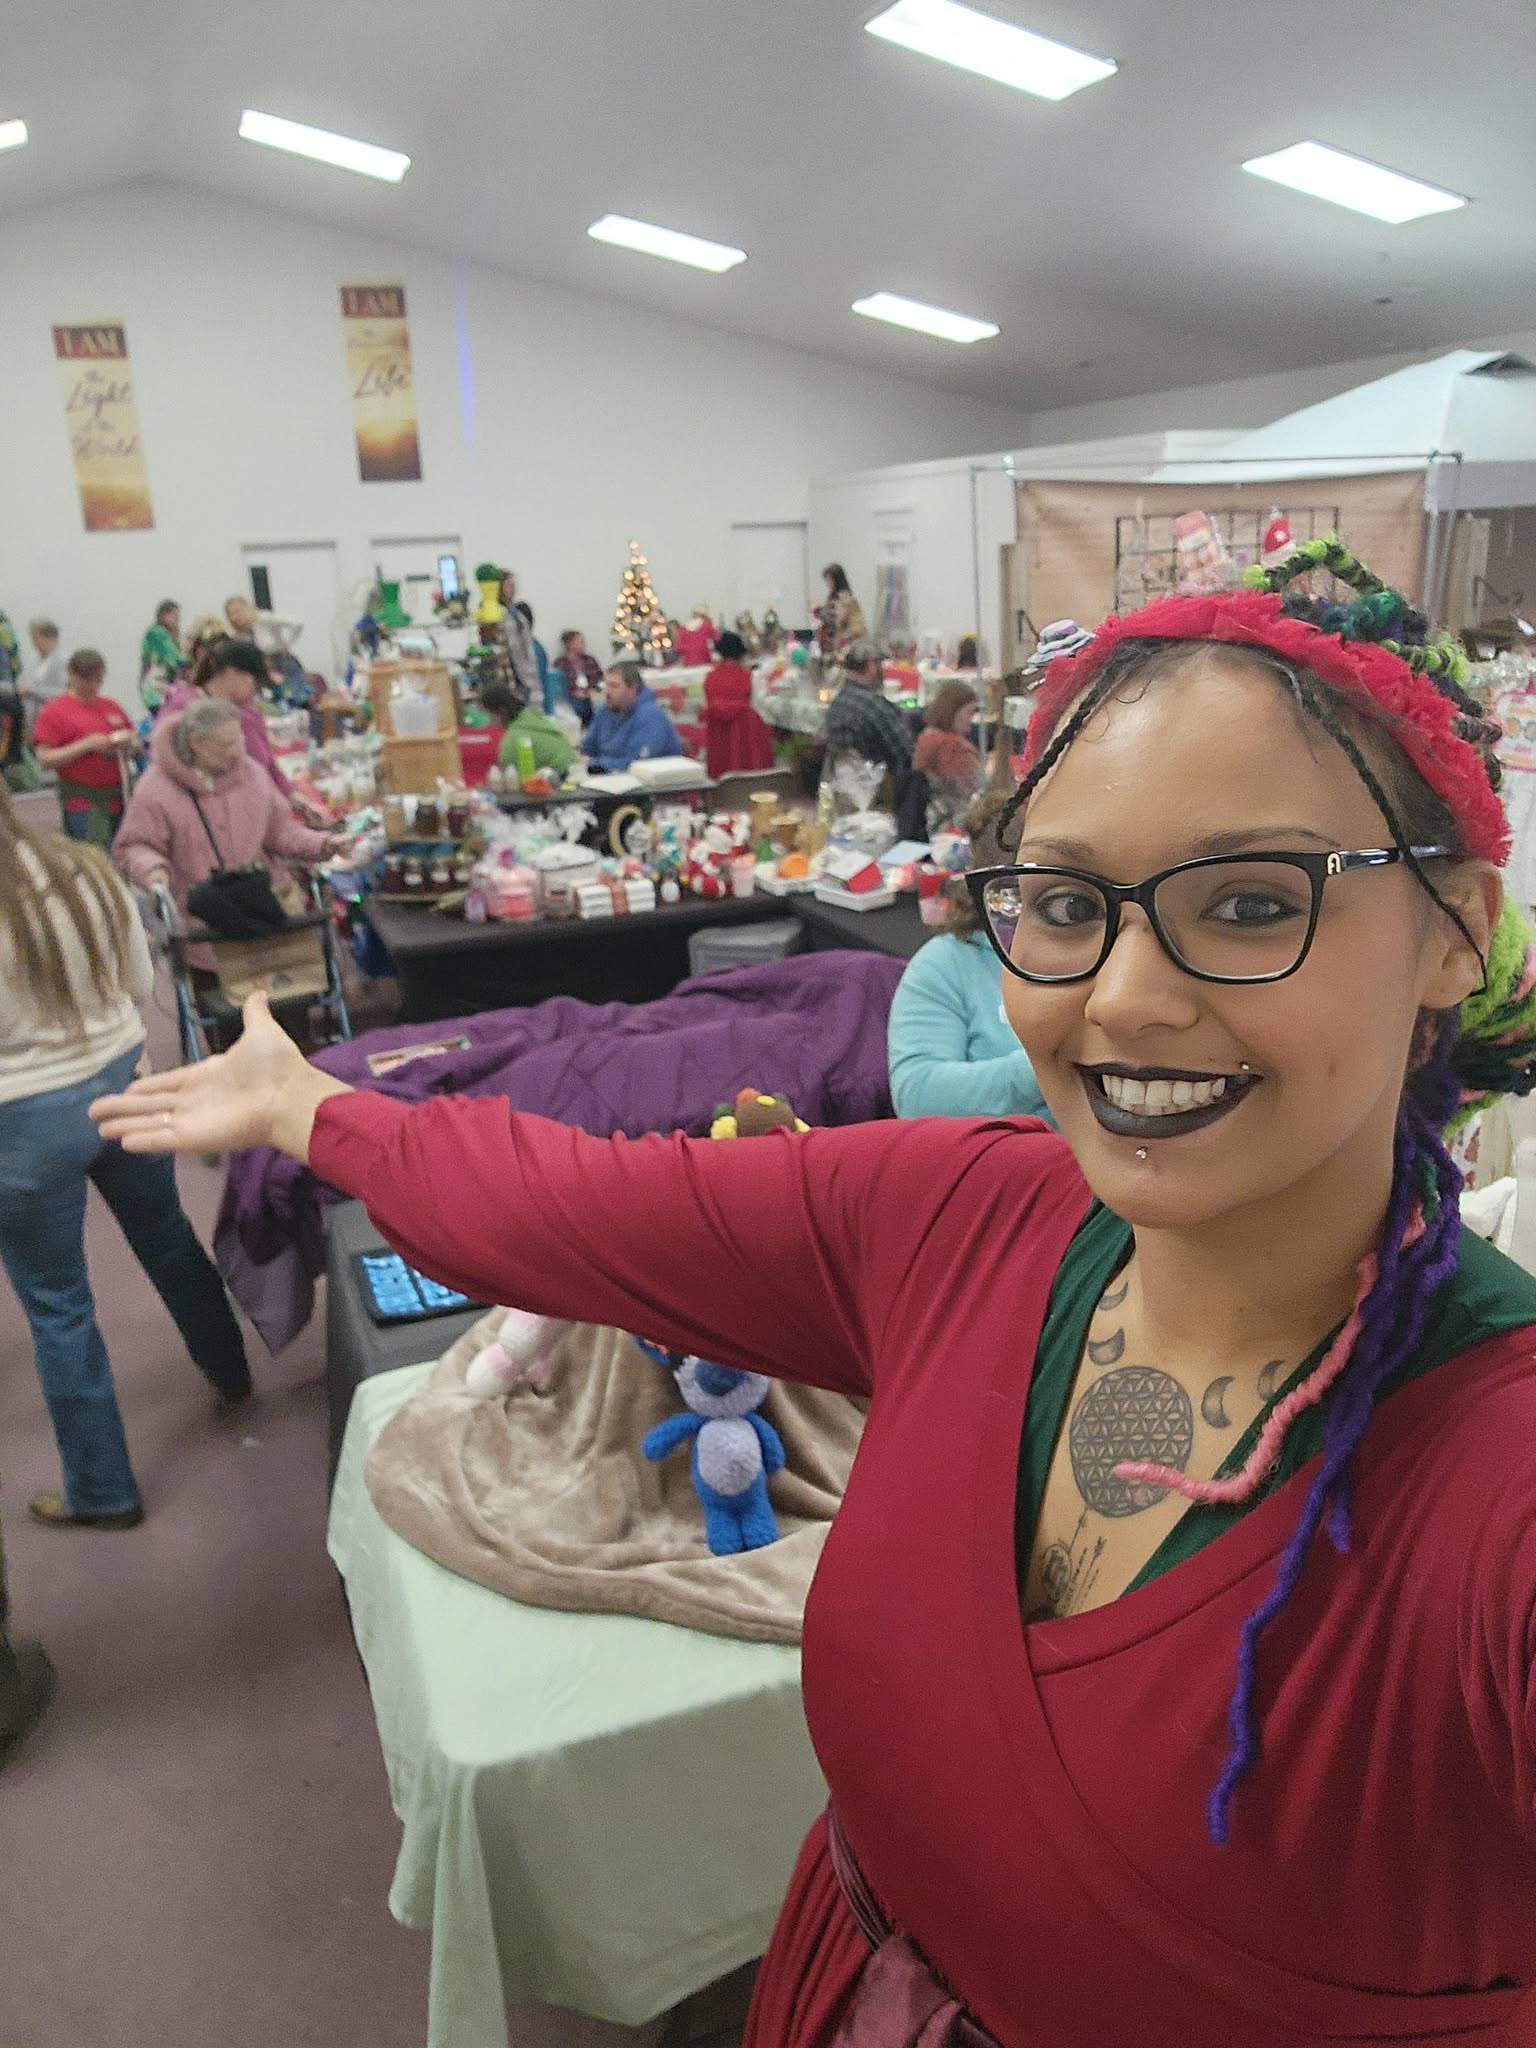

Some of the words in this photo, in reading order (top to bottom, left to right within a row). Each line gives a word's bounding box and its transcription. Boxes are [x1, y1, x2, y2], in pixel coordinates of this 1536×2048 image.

[366, 291, 400, 315] AM
[62, 330, 73, 355] I
[80, 329, 120, 355] AM
[353, 361, 410, 399] Life
[66, 381, 132, 418] Light
